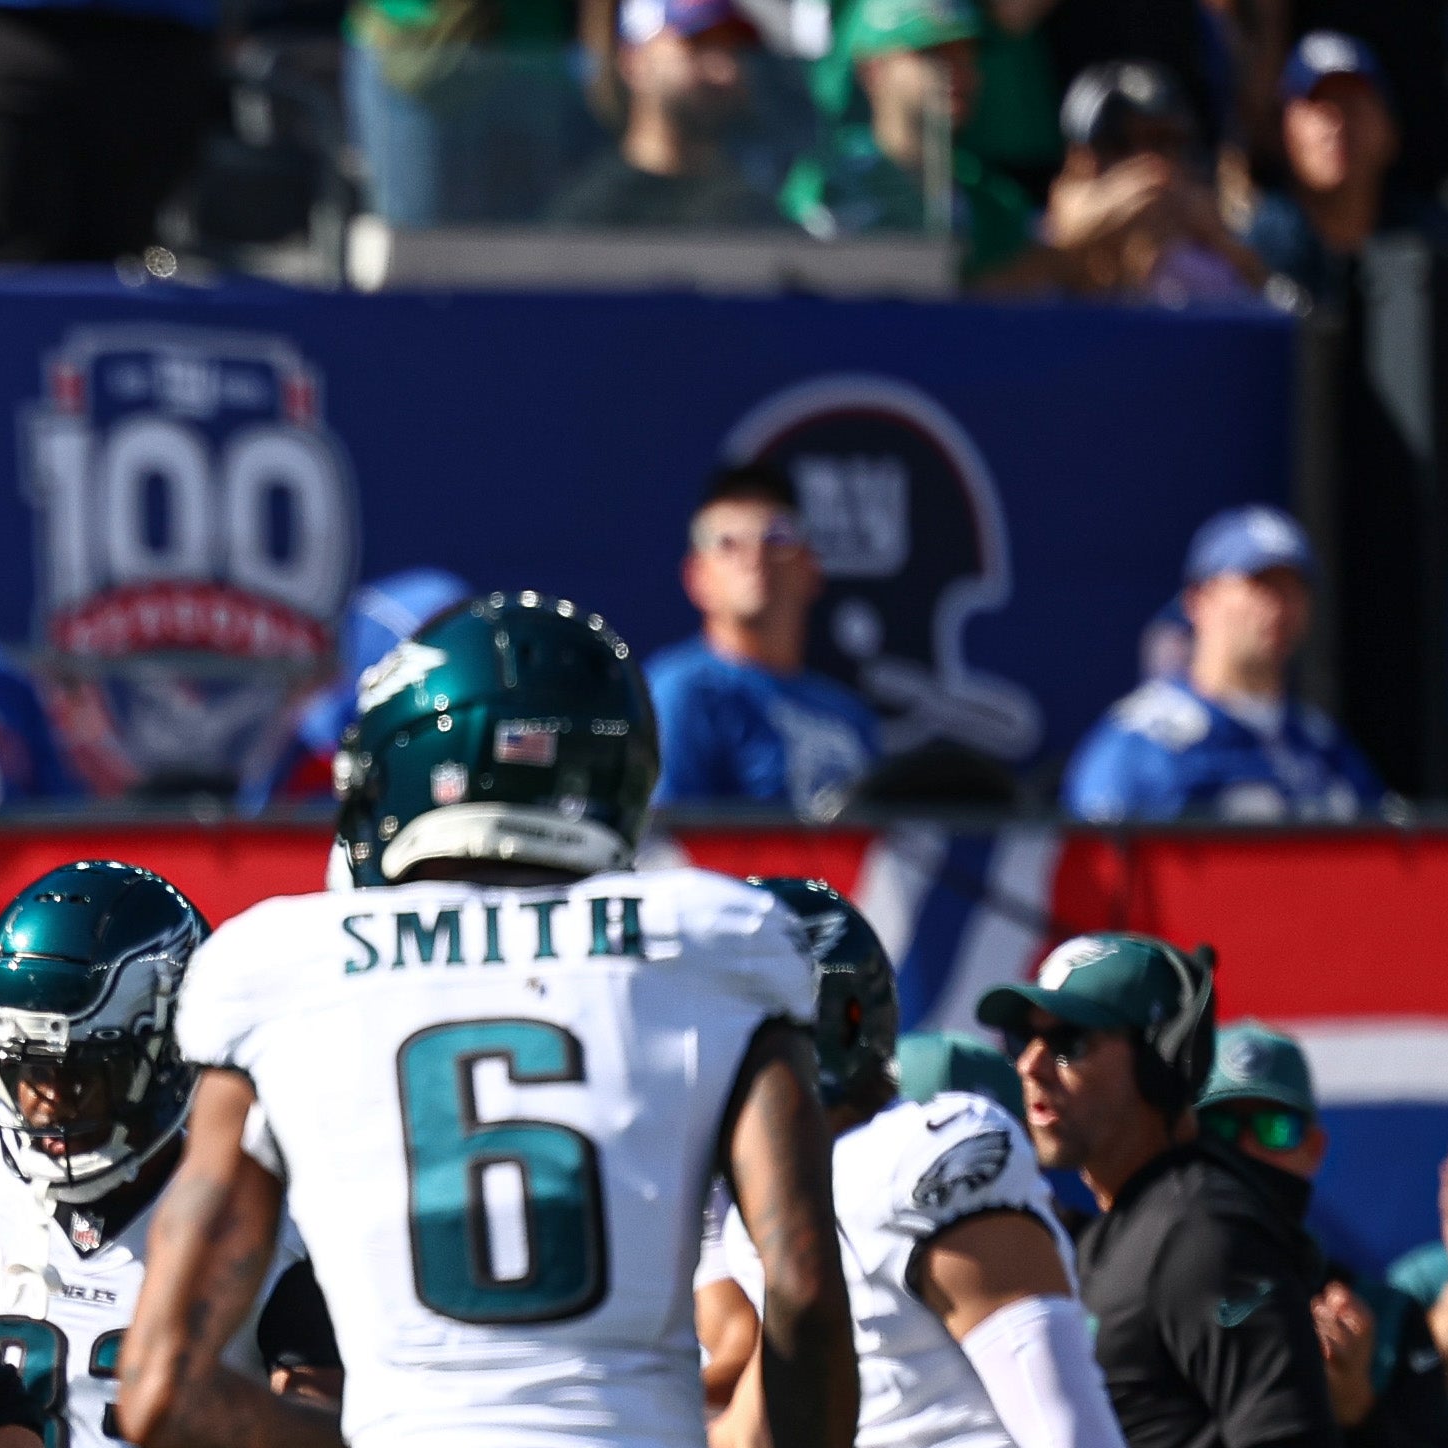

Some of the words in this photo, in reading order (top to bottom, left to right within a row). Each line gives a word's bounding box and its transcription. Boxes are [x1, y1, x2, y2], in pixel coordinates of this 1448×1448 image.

[28, 415, 343, 622] 100
[343, 896, 646, 976] SMITH
[396, 1016, 611, 1325] 6
[61, 1284, 118, 1305] GLES
